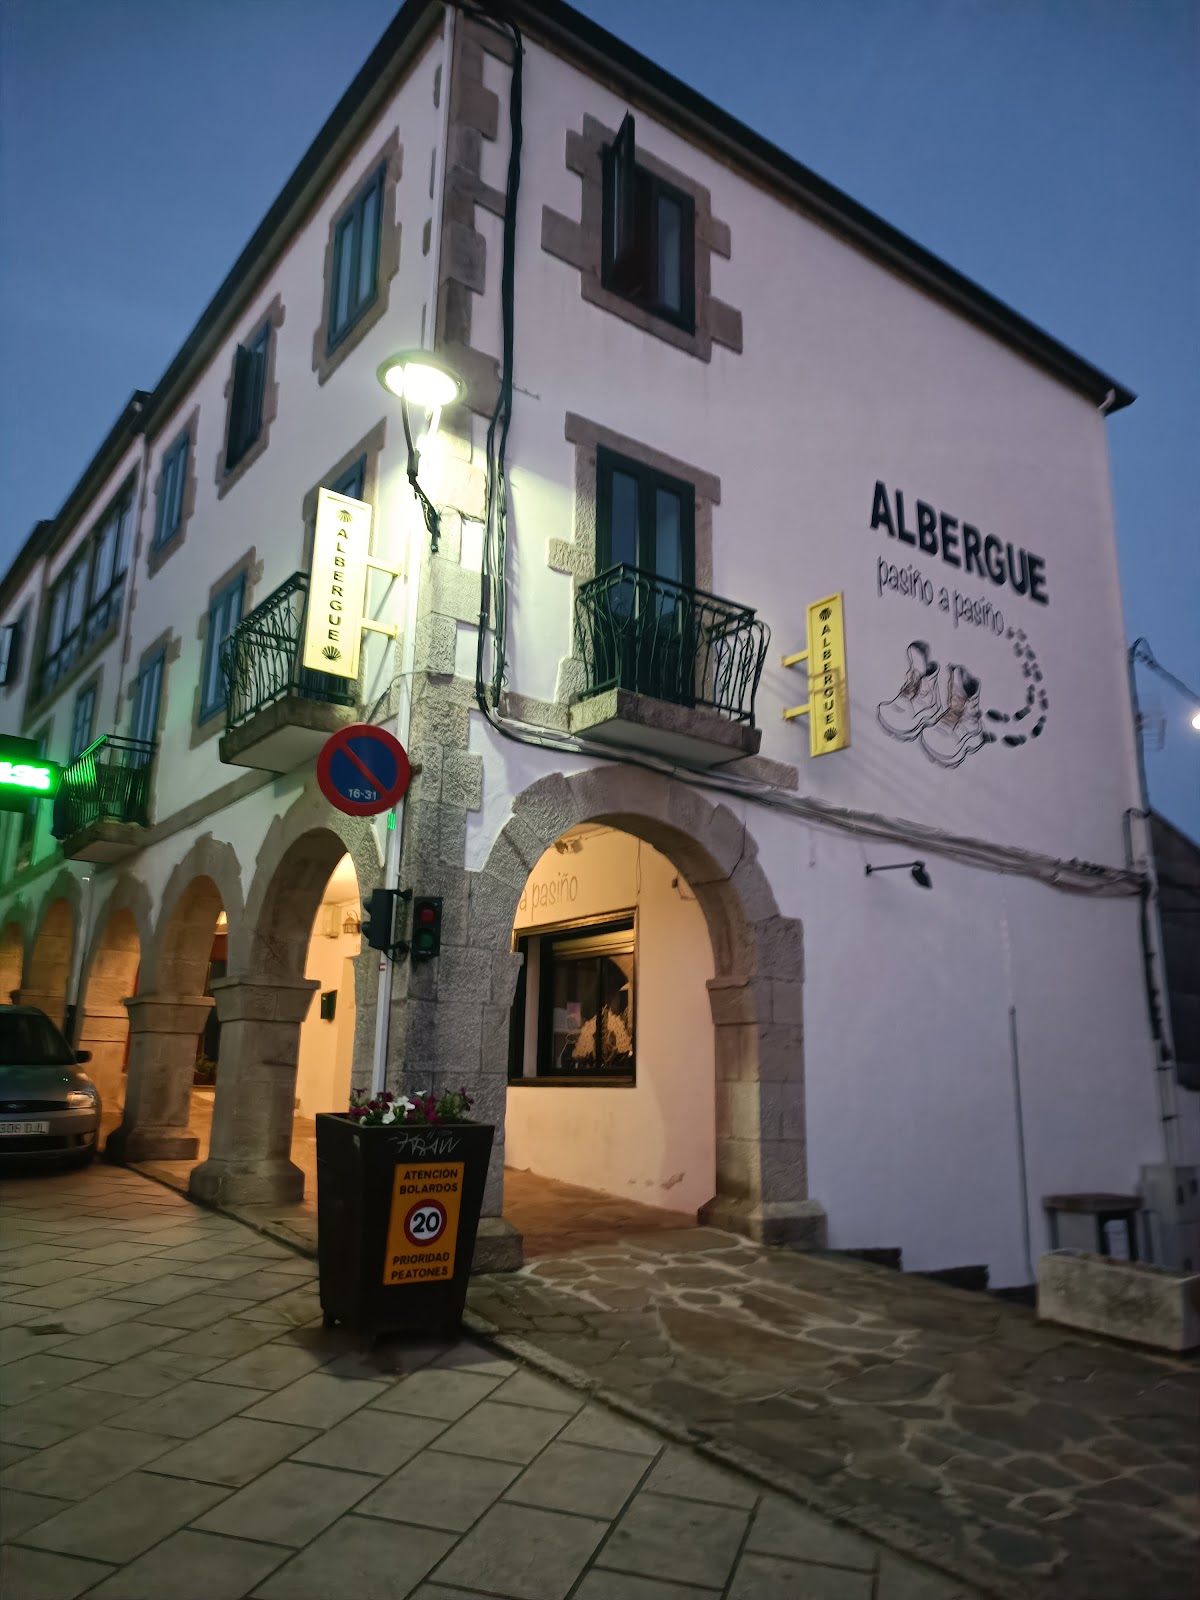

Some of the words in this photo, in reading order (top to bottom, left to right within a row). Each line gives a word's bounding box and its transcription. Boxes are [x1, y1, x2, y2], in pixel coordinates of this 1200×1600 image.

[870, 479, 1049, 606] ALBERGUE
[328, 528, 349, 642] ALBERGUE
[877, 555, 933, 606] pasiño
[938, 586, 950, 612] a
[953, 589, 1004, 636] pasiño
[821, 624, 835, 725] ALBERGUE
[348, 788, 377, 800] 16-31
[532, 872, 578, 921] pasiño
[399, 1183, 458, 1195] BOLARDOS
[412, 1211, 440, 1233] 20
[391, 1266, 448, 1280] PEATONES
[392, 1252, 450, 1265] PRIORIDAD
